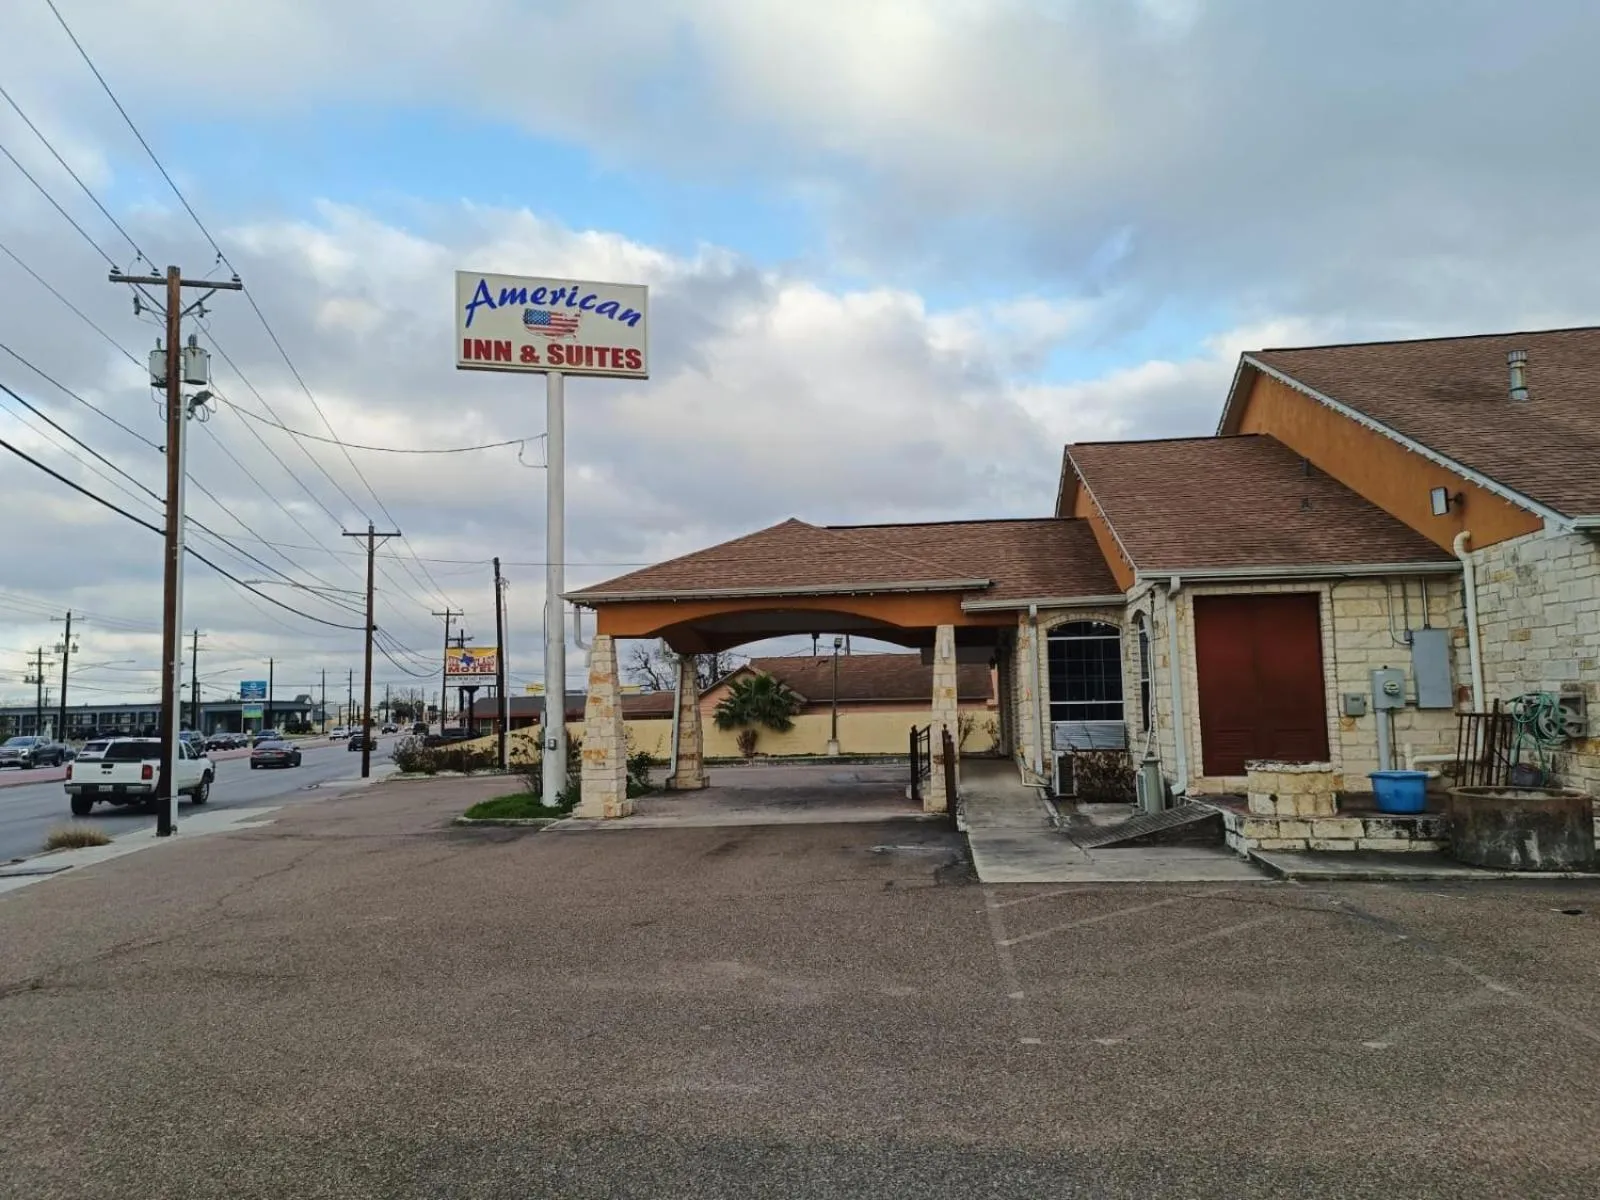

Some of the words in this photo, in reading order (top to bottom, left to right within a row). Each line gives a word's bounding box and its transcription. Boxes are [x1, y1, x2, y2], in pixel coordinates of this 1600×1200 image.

[465, 278, 642, 328] American
[463, 338, 512, 362] INN
[520, 345, 540, 364] &
[547, 343, 642, 370] SUITES
